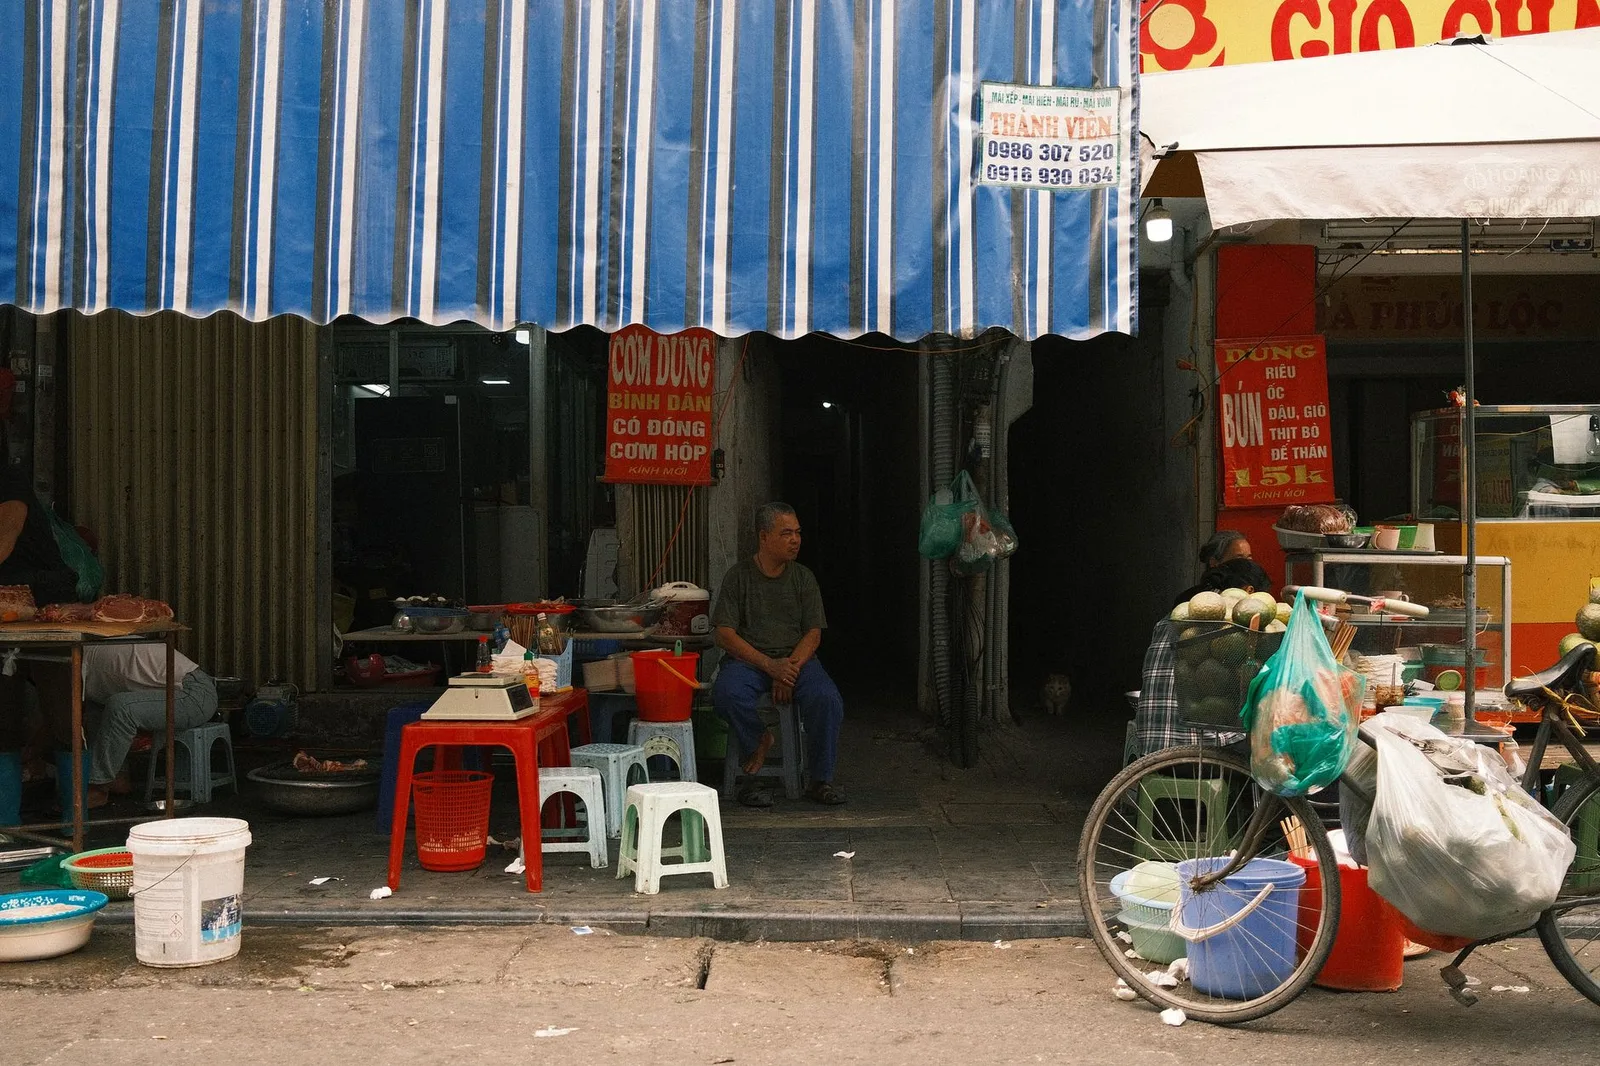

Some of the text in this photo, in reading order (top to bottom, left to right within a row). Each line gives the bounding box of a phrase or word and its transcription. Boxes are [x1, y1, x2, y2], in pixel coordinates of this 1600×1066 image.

[988, 140, 1114, 162] 0986 307 520
[987, 164, 1113, 185] 0916 930 034
[1487, 291, 1562, 334] LỘC
[611, 330, 653, 386] CƠM
[1265, 363, 1296, 379] RIÊU
[608, 390, 711, 412] BÌNH DÂN
[1266, 382, 1285, 400] ỐC
[1222, 380, 1264, 448] BÚN
[1303, 402, 1326, 418] GIÒ
[613, 416, 706, 437] CÓ ĐÓNG
[1269, 422, 1320, 443] THỊT BÒ
[610, 441, 707, 464] CƠM HỘP
